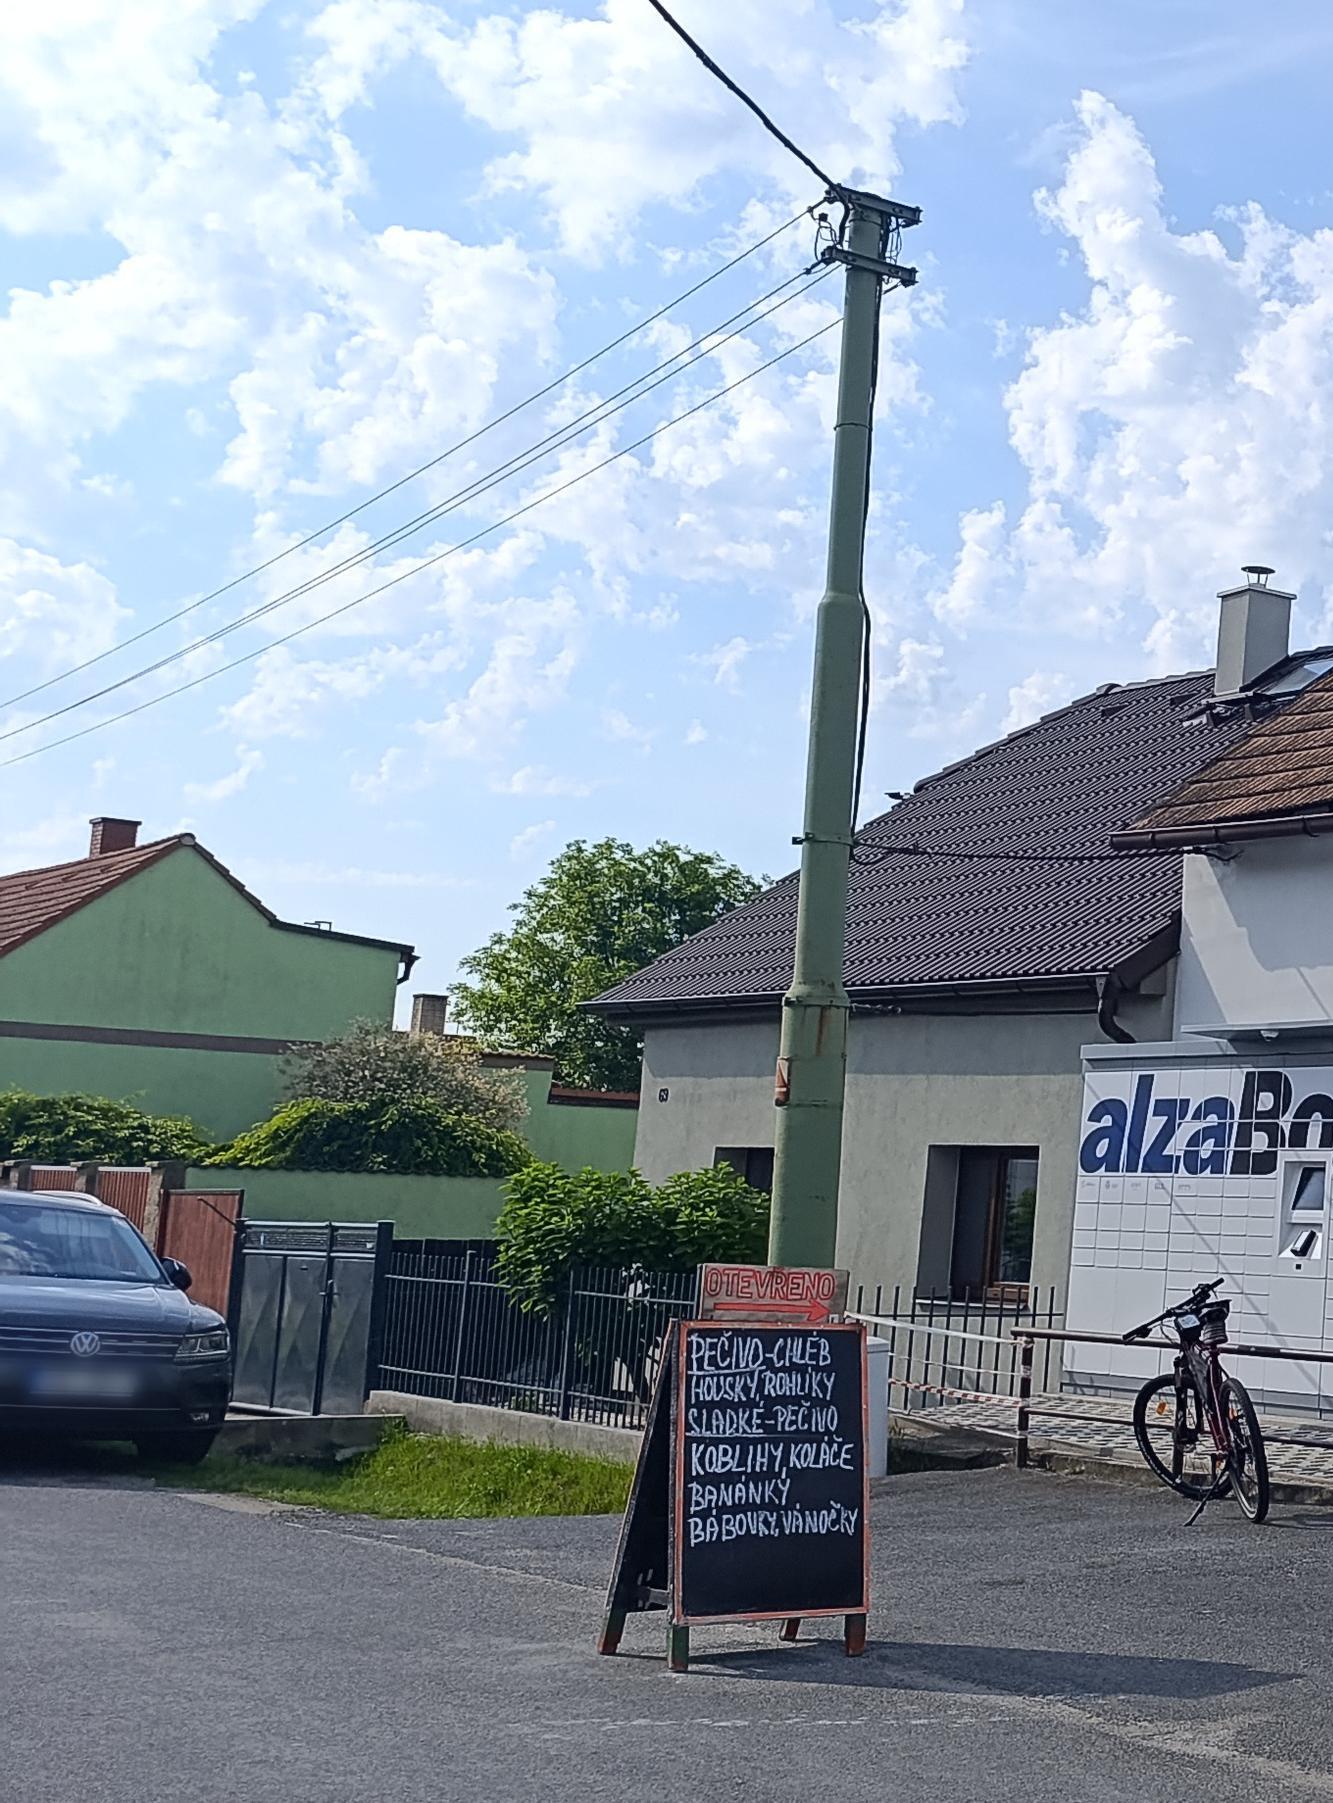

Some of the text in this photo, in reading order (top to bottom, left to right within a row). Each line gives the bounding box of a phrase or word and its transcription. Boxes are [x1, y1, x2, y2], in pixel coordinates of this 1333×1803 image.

[705, 1266, 835, 1300] OTEVŘENO
[762, 1367, 836, 1401] ROHLÍKY
[789, 1435, 855, 1470] KOLÁČE
[688, 1474, 791, 1515] BANÁNKY
[780, 1500, 859, 1537] VÁNOČKY
